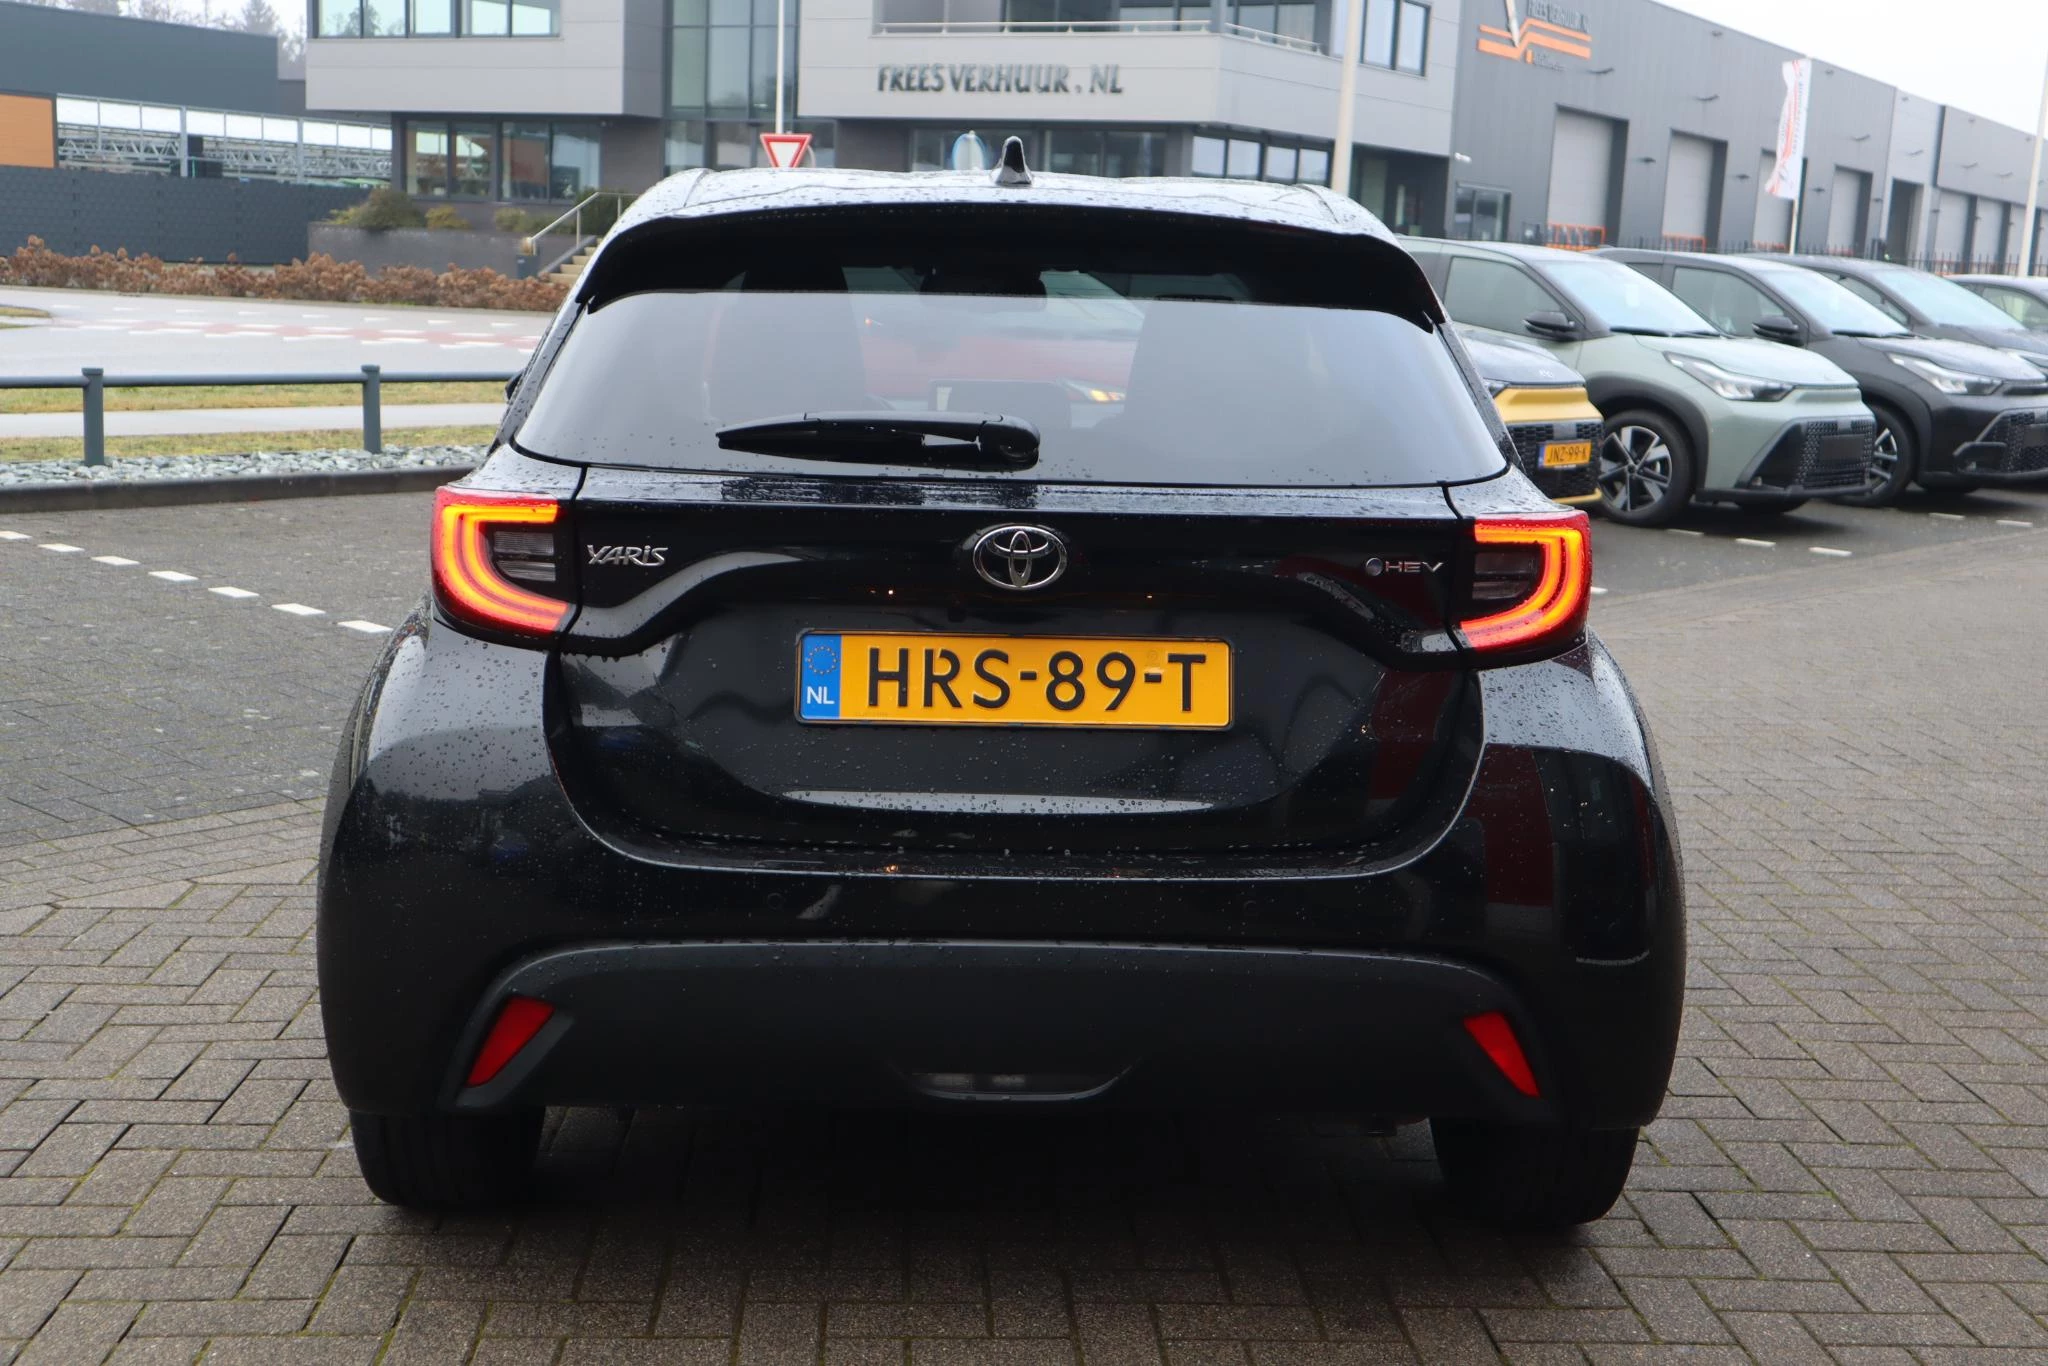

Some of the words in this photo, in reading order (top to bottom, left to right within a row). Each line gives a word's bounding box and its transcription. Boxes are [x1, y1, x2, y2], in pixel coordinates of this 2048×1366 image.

[1385, 560, 1443, 573] HEV
[868, 647, 1207, 712] HRS-89-T
[807, 687, 835, 705] NL
